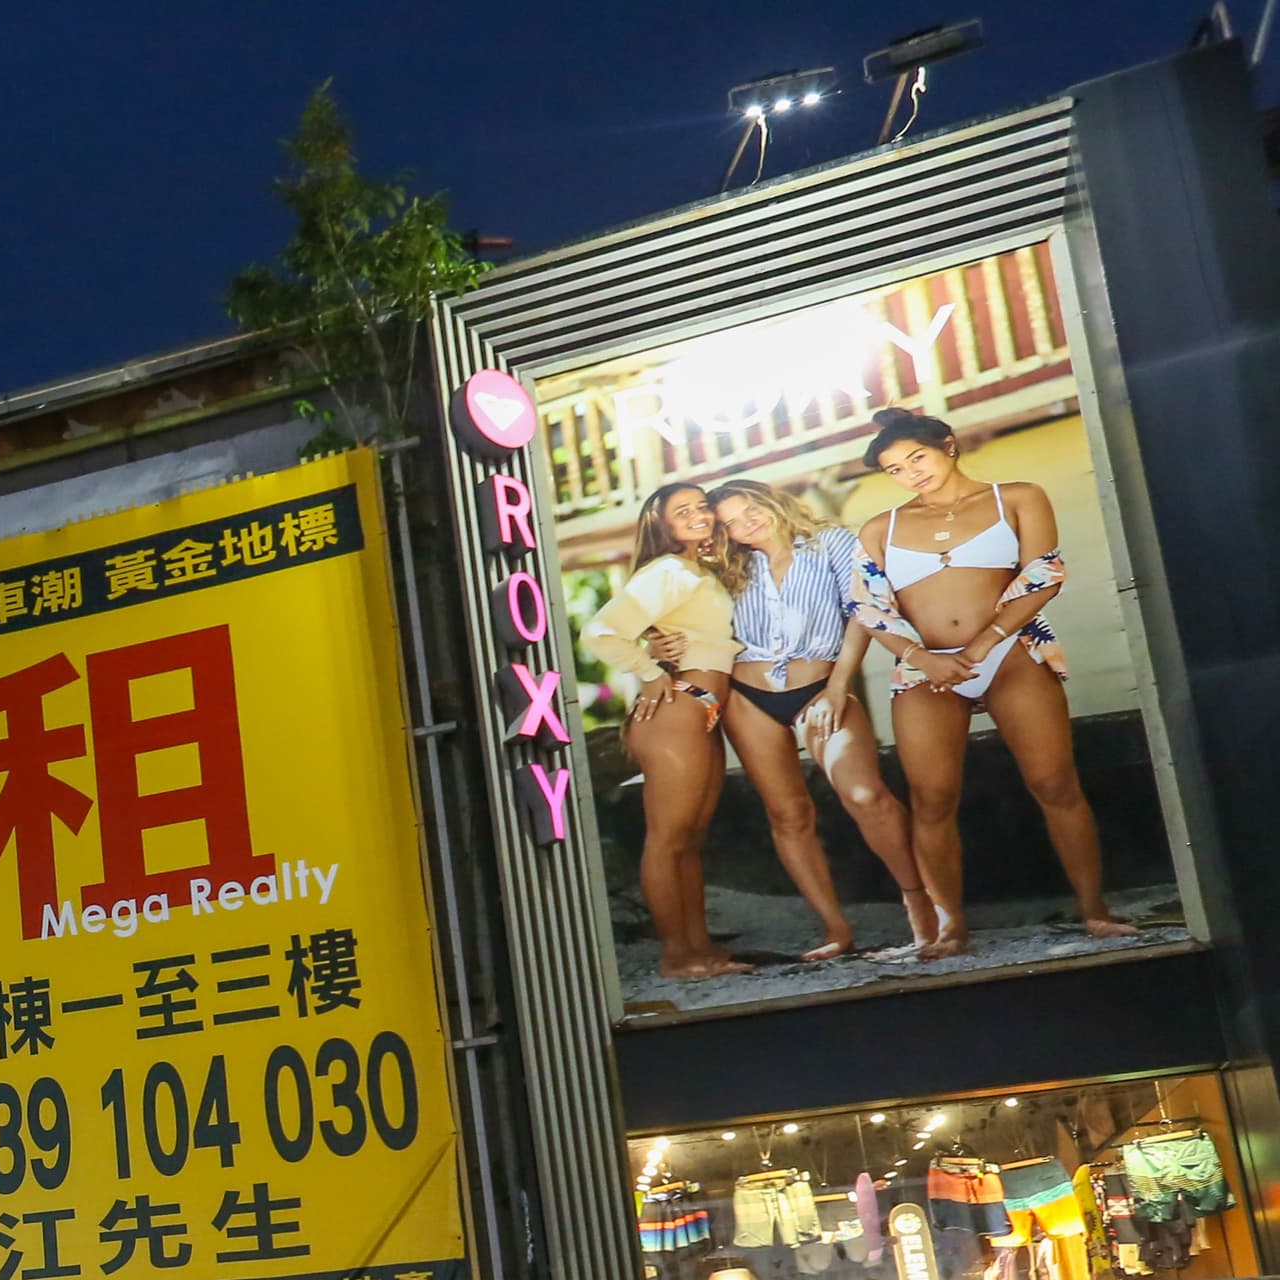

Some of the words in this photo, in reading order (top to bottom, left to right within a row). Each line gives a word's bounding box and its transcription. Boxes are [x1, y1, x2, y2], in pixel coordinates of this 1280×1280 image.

[614, 303, 957, 458] RY
[105, 504, 340, 600] 黃金地標
[490, 474, 570, 843] ROXY
[40, 889, 169, 940] Mega
[190, 860, 338, 915] Realty
[102, 1055, 240, 1179] 104
[264, 1031, 419, 1161] 030
